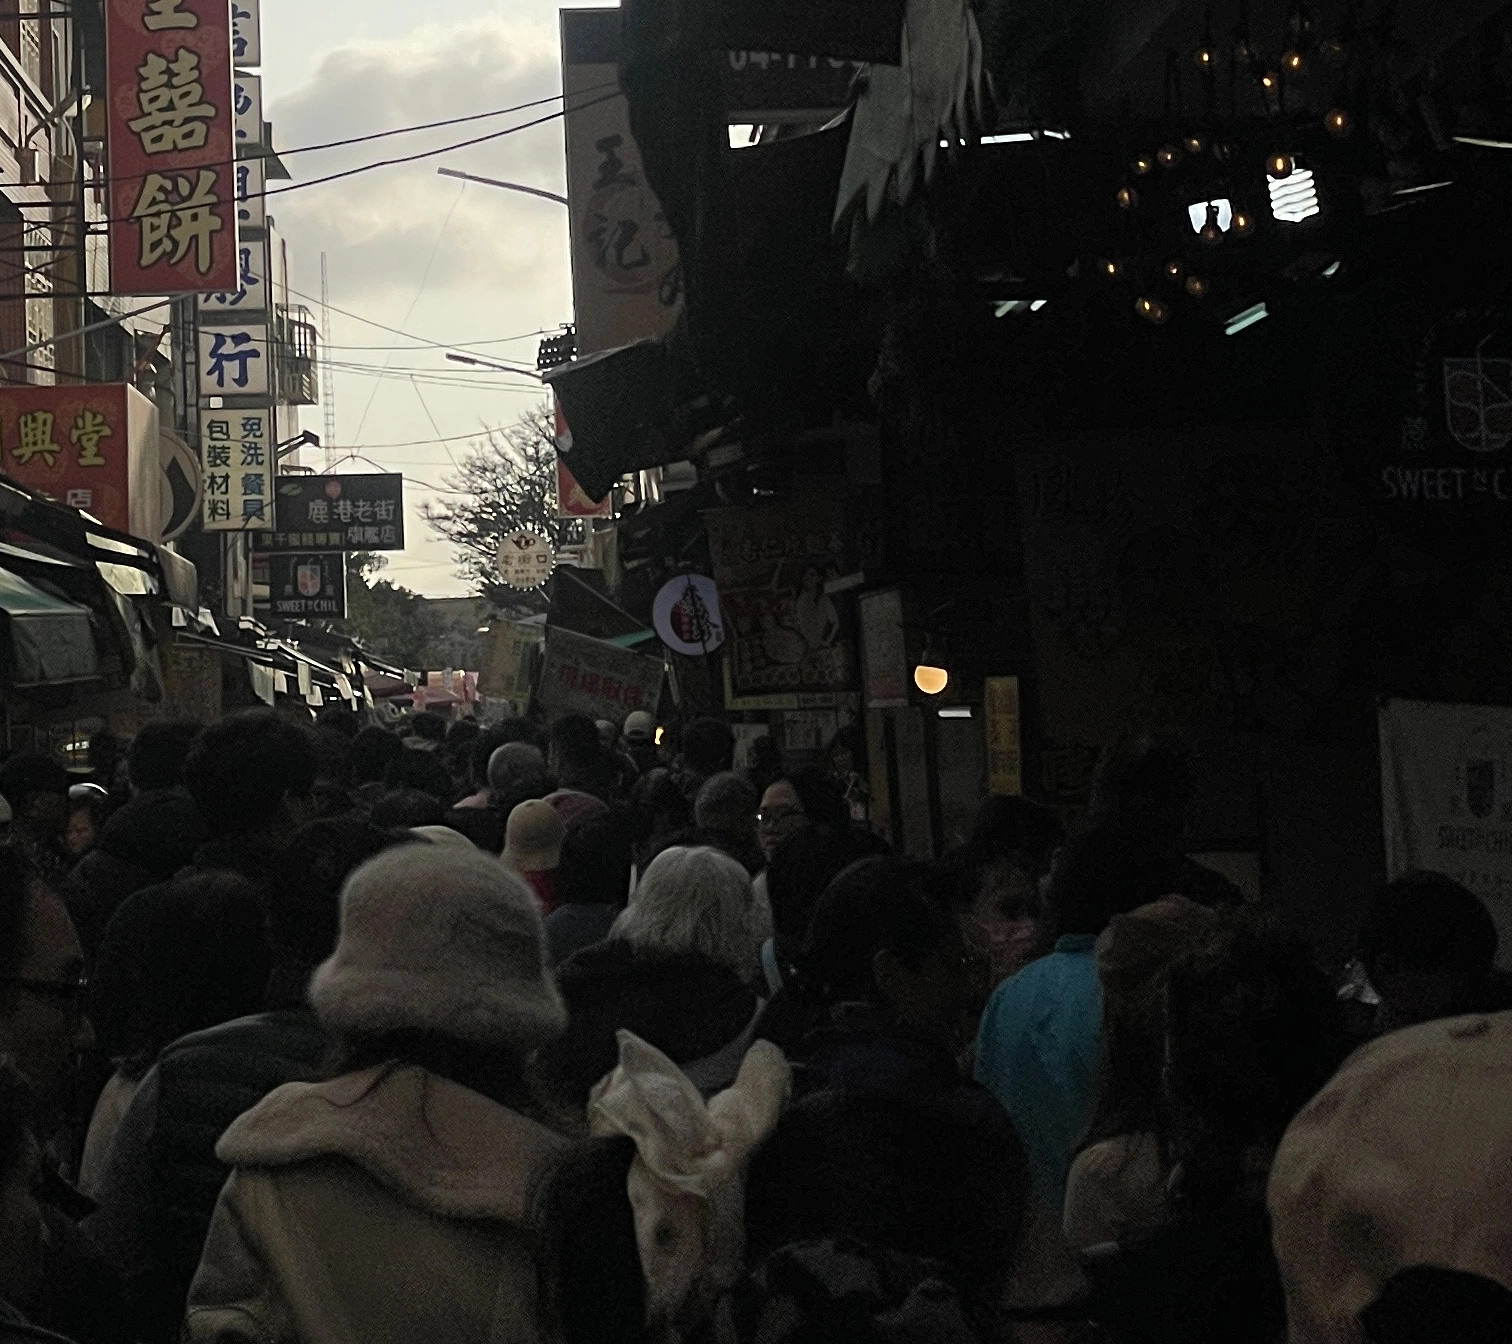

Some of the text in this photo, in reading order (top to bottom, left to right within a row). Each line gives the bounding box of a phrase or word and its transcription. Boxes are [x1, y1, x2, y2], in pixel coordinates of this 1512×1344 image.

[206, 419, 232, 522] 包裝材料
[240, 416, 265, 523] 免洗餐具
[307, 498, 396, 524] 鹿港老街
